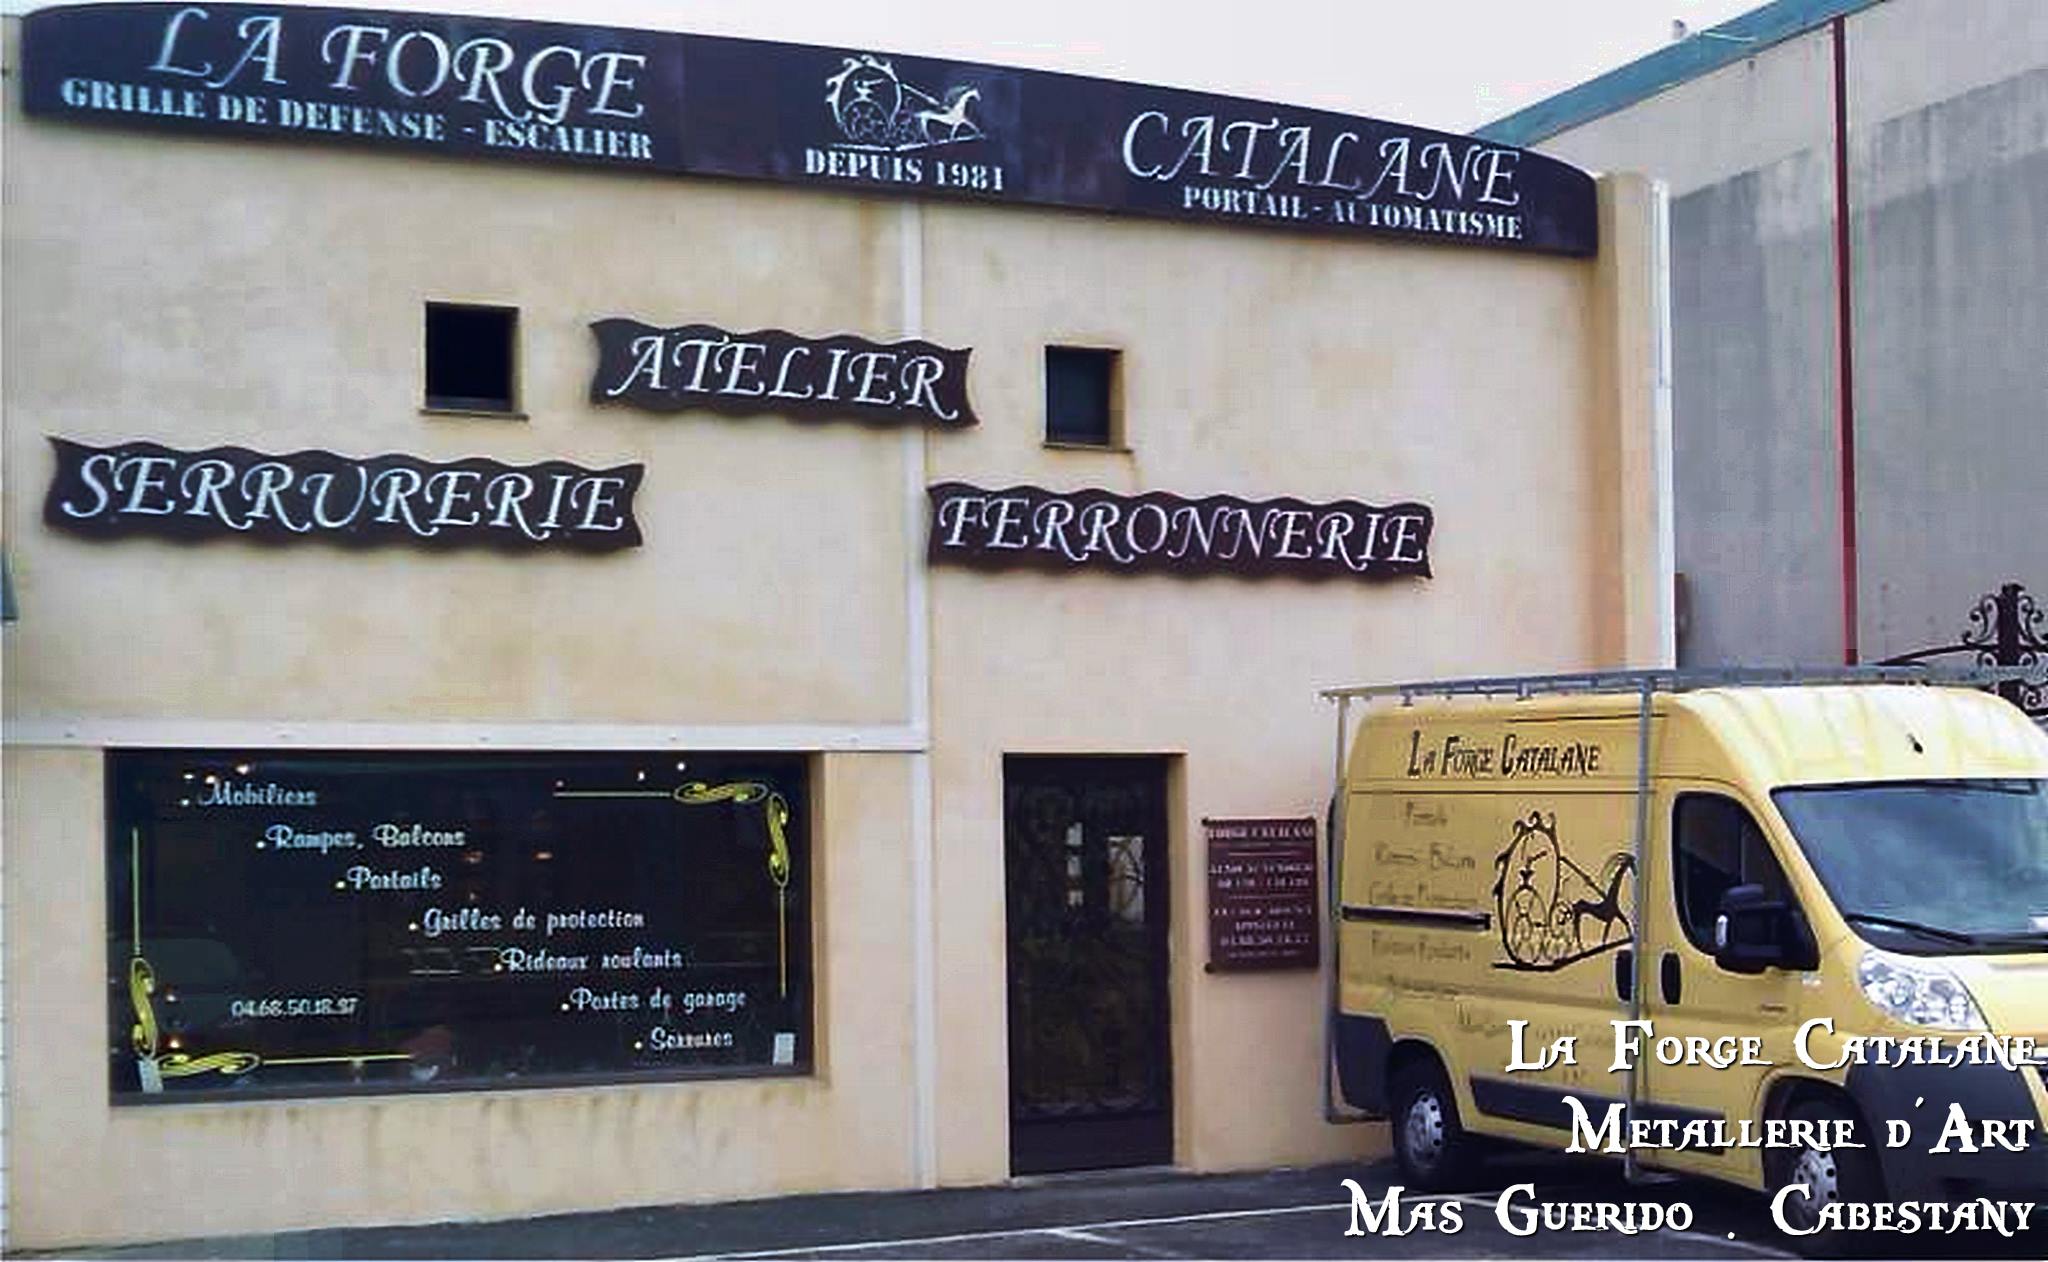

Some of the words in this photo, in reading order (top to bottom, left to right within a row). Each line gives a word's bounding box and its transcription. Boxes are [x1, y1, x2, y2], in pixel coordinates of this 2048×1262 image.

[148, 6, 290, 90] LA
[318, 22, 648, 126] FORGE
[60, 77, 206, 118] GRILLE
[218, 94, 268, 124] DE
[279, 98, 447, 142] DEFENSE
[483, 117, 653, 160] ESCALIER
[804, 146, 924, 186] DEPUIS
[934, 160, 1005, 192] 1981
[1122, 110, 1523, 207] CATALANE
[1182, 184, 1308, 220] PORTAIL
[1330, 198, 1524, 240] AUTOMATISME
[606, 334, 959, 421] ATELIER
[60, 453, 626, 540] SERRURERIE
[937, 495, 1428, 572] FERRONNERIE
[198, 780, 318, 806] Mobiliers
[371, 823, 466, 848] Balcons
[346, 865, 442, 890] Portails
[423, 907, 504, 938] Grilles
[512, 907, 537, 930] de
[546, 910, 646, 937] protection
[501, 945, 590, 973] Rideaux
[601, 946, 684, 971] roulants
[570, 986, 640, 1013] Portes
[649, 985, 673, 1012] de
[683, 990, 747, 1014] garage
[650, 1026, 735, 1052] Serrures
